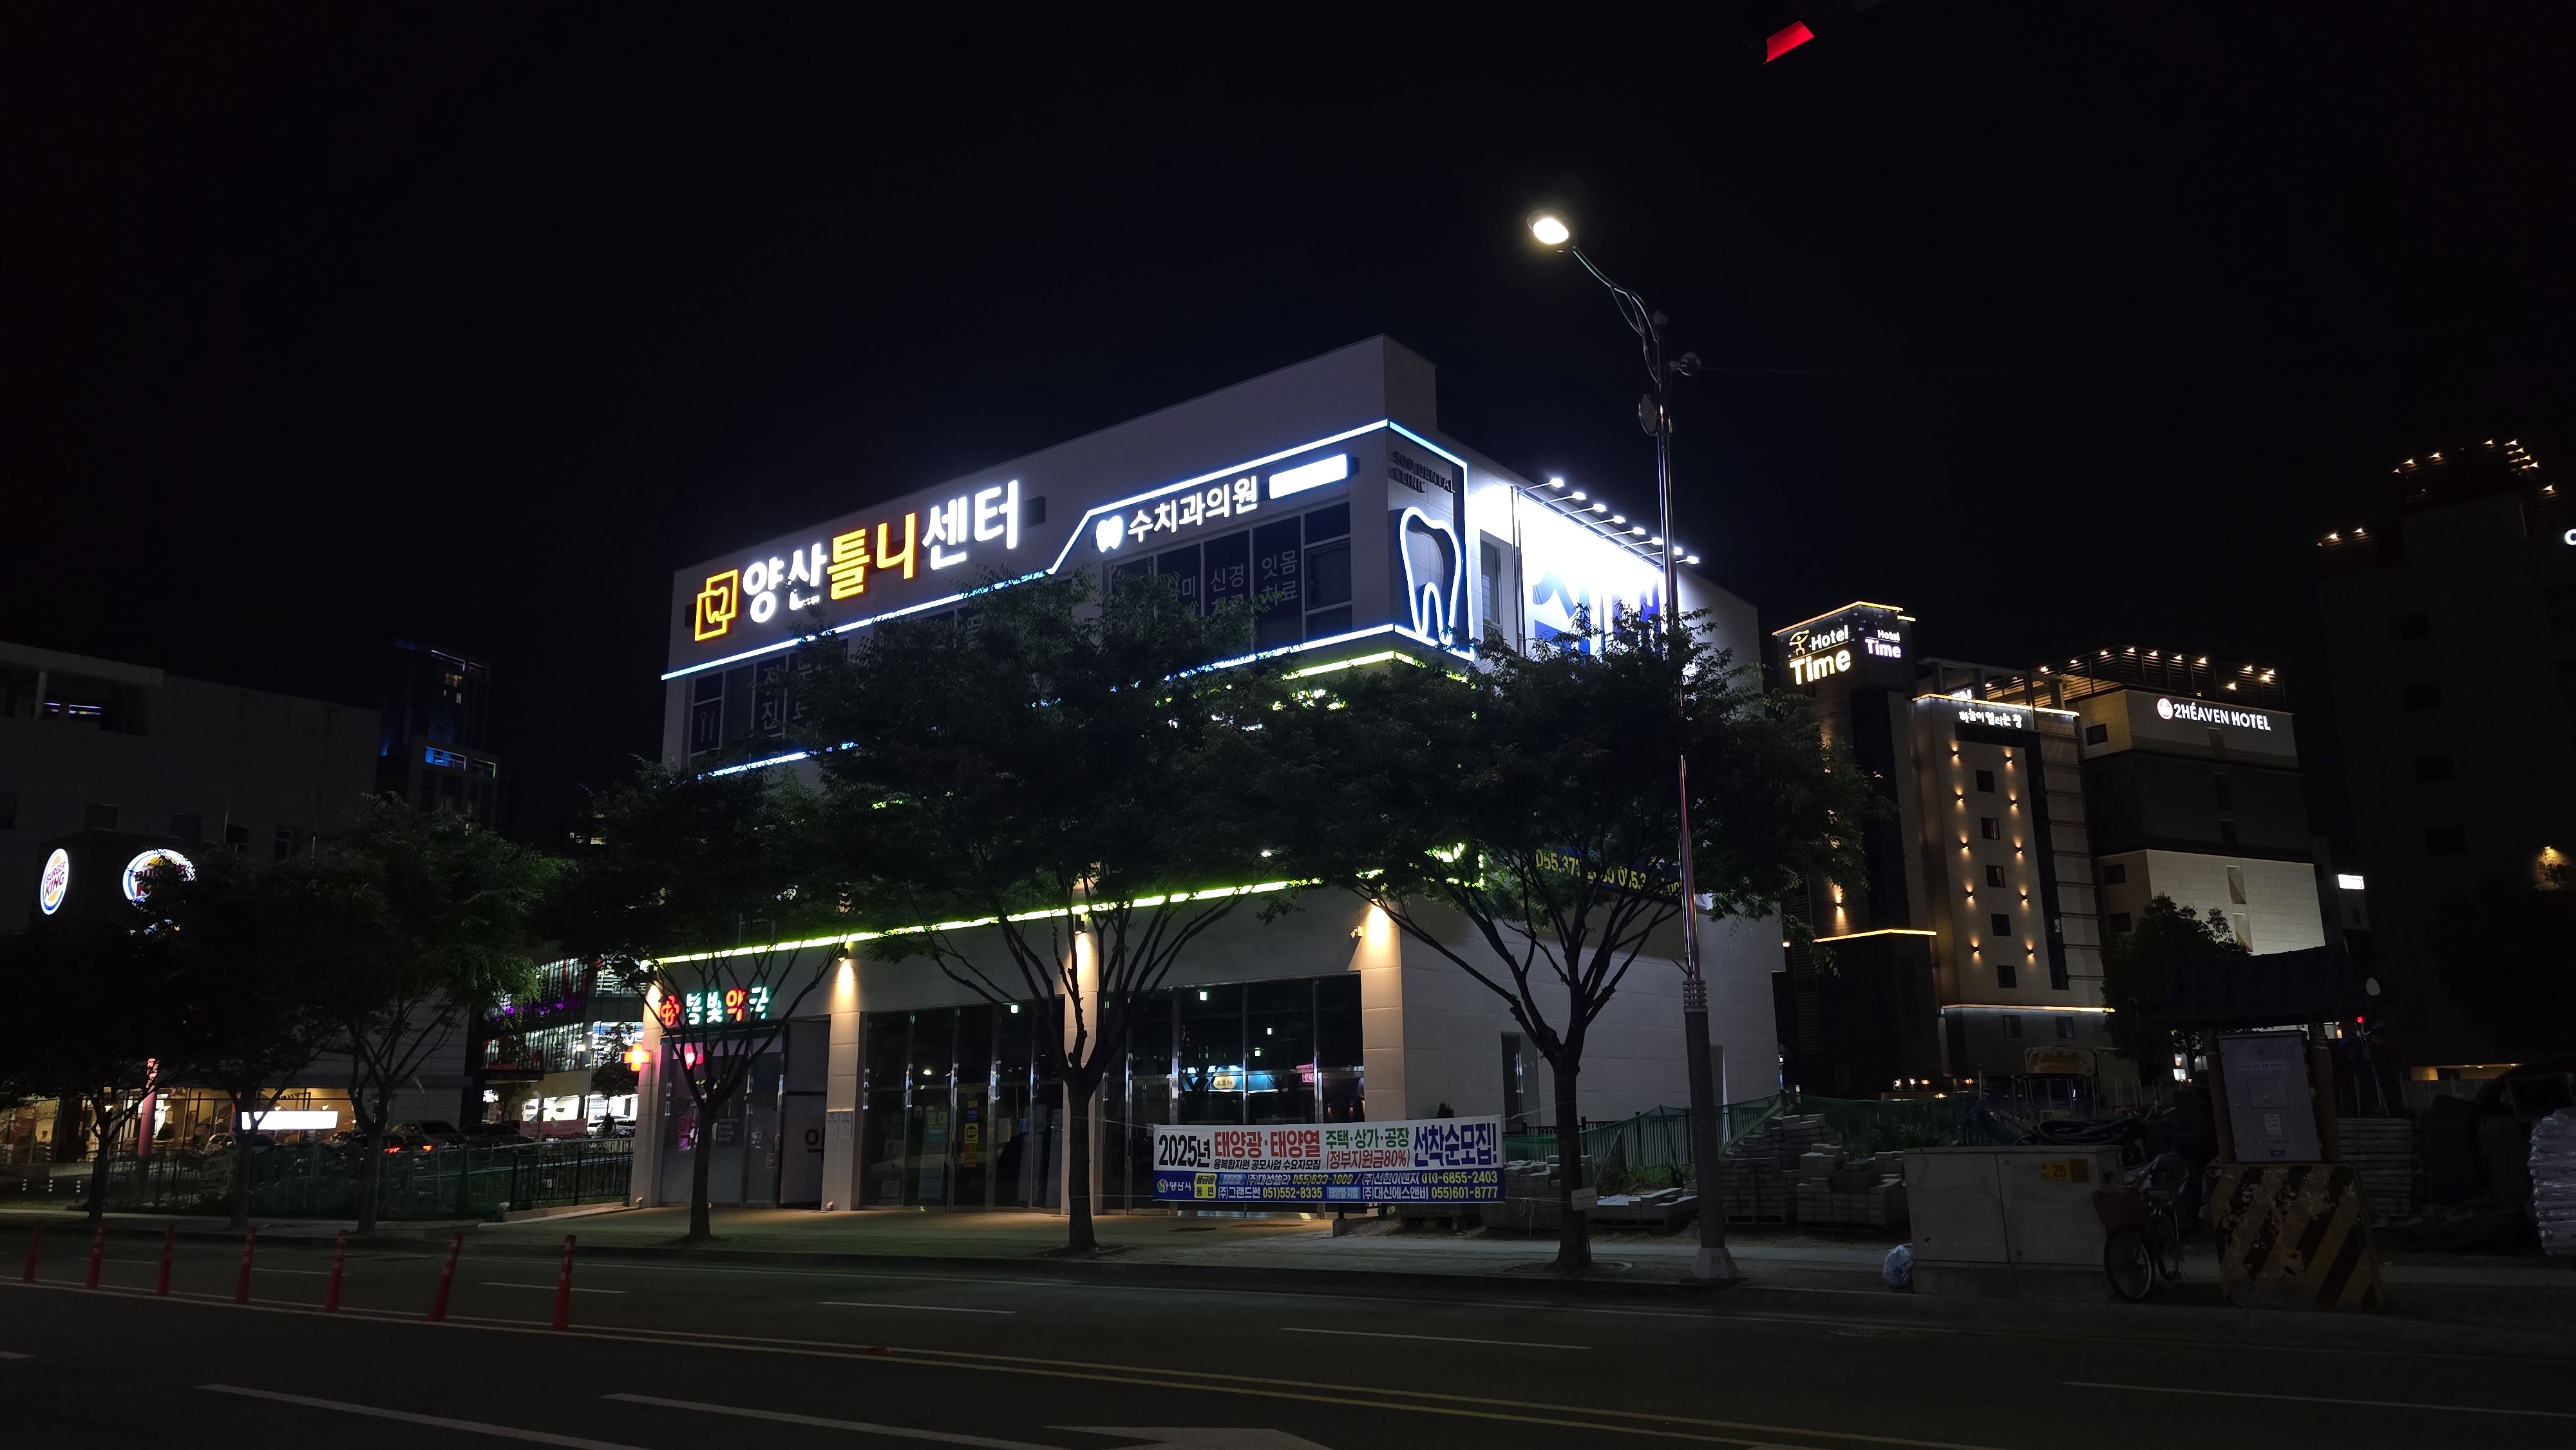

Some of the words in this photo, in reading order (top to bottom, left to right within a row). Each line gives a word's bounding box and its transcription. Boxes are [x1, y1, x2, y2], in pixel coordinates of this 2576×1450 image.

[1393, 451, 1414, 471] SOO
[1418, 463, 1455, 493] DENTAL
[1393, 467, 1426, 493] CLINIC
[1128, 476, 1258, 543] 수치과의원
[743, 480, 1019, 623] 양산틀니센터
[1262, 550, 1298, 579] 잇몸
[1210, 563, 1244, 592] 신경
[1812, 625, 1849, 651] Hotel
[1877, 629, 1900, 641] Hotel
[1864, 638, 1902, 659] Time
[1789, 650, 1852, 685] Time
[2174, 702, 2230, 725] 2HÉAVEN
[2231, 710, 2271, 731] HOTEL
[44, 872, 65, 898] KING
[46, 861, 66, 885] BURGER
[1159, 1134, 1211, 1168] 2025년
[1414, 1122, 1497, 1167] 선착순모집!
[1213, 1159, 1250, 1171] 융복합지원
[1251, 1158, 1282, 1171] 공모사업
[1282, 1158, 1321, 1171] 수요자모집
[1325, 1148, 1410, 1171] (정부지원금80%)
[2052, 1164, 2067, 1178] 25
[1170, 1181, 1191, 1192] 양산시
[1292, 1173, 1354, 1185] 055)633-1009
[1421, 1170, 1498, 1184] 010-6855-2403
[1218, 1186, 1260, 1199] (주)그랜드썬
[1262, 1186, 1323, 1199] 051)552-8335
[1362, 1186, 1428, 1200] (주)대신에스앤비
[1431, 1185, 1499, 1200] 055)601-8777
